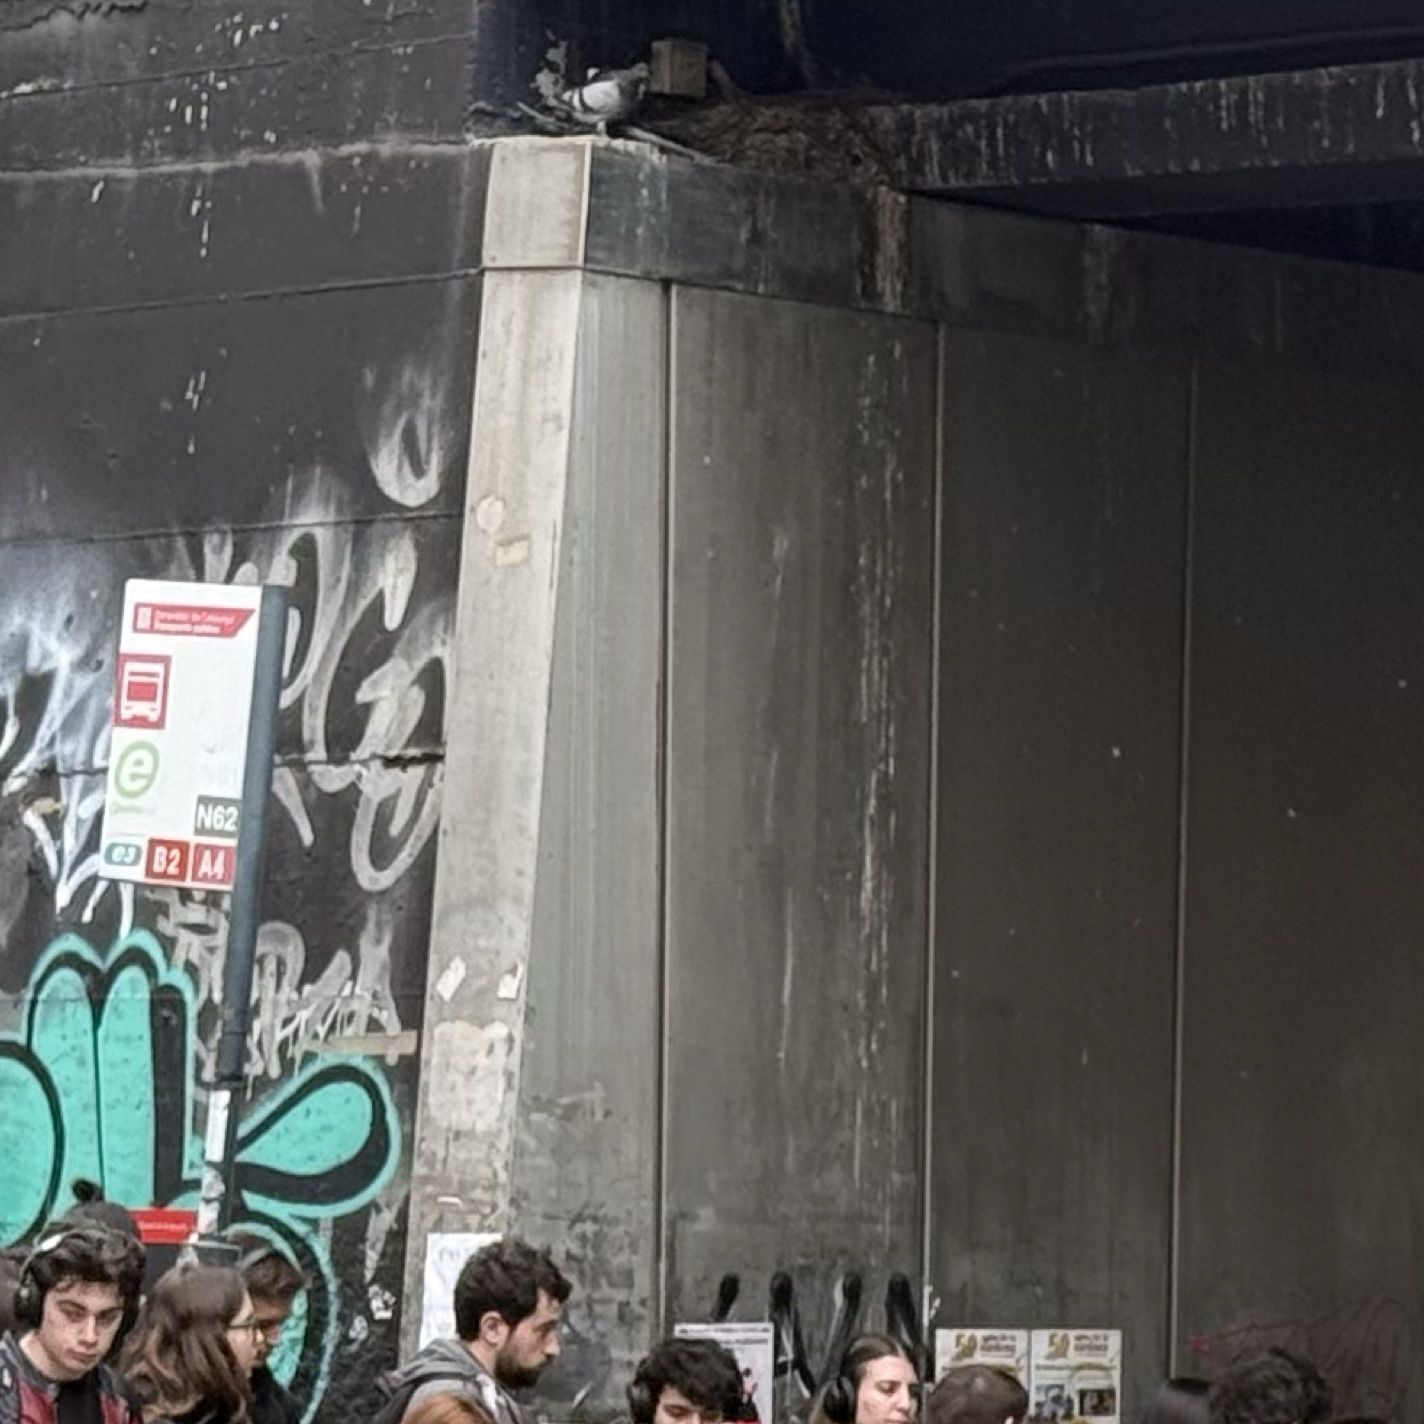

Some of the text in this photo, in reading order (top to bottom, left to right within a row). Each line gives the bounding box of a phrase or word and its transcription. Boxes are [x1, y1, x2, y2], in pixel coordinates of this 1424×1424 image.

[196, 803, 239, 831] N62
[152, 845, 181, 875] B2
[197, 849, 226, 880] A4
